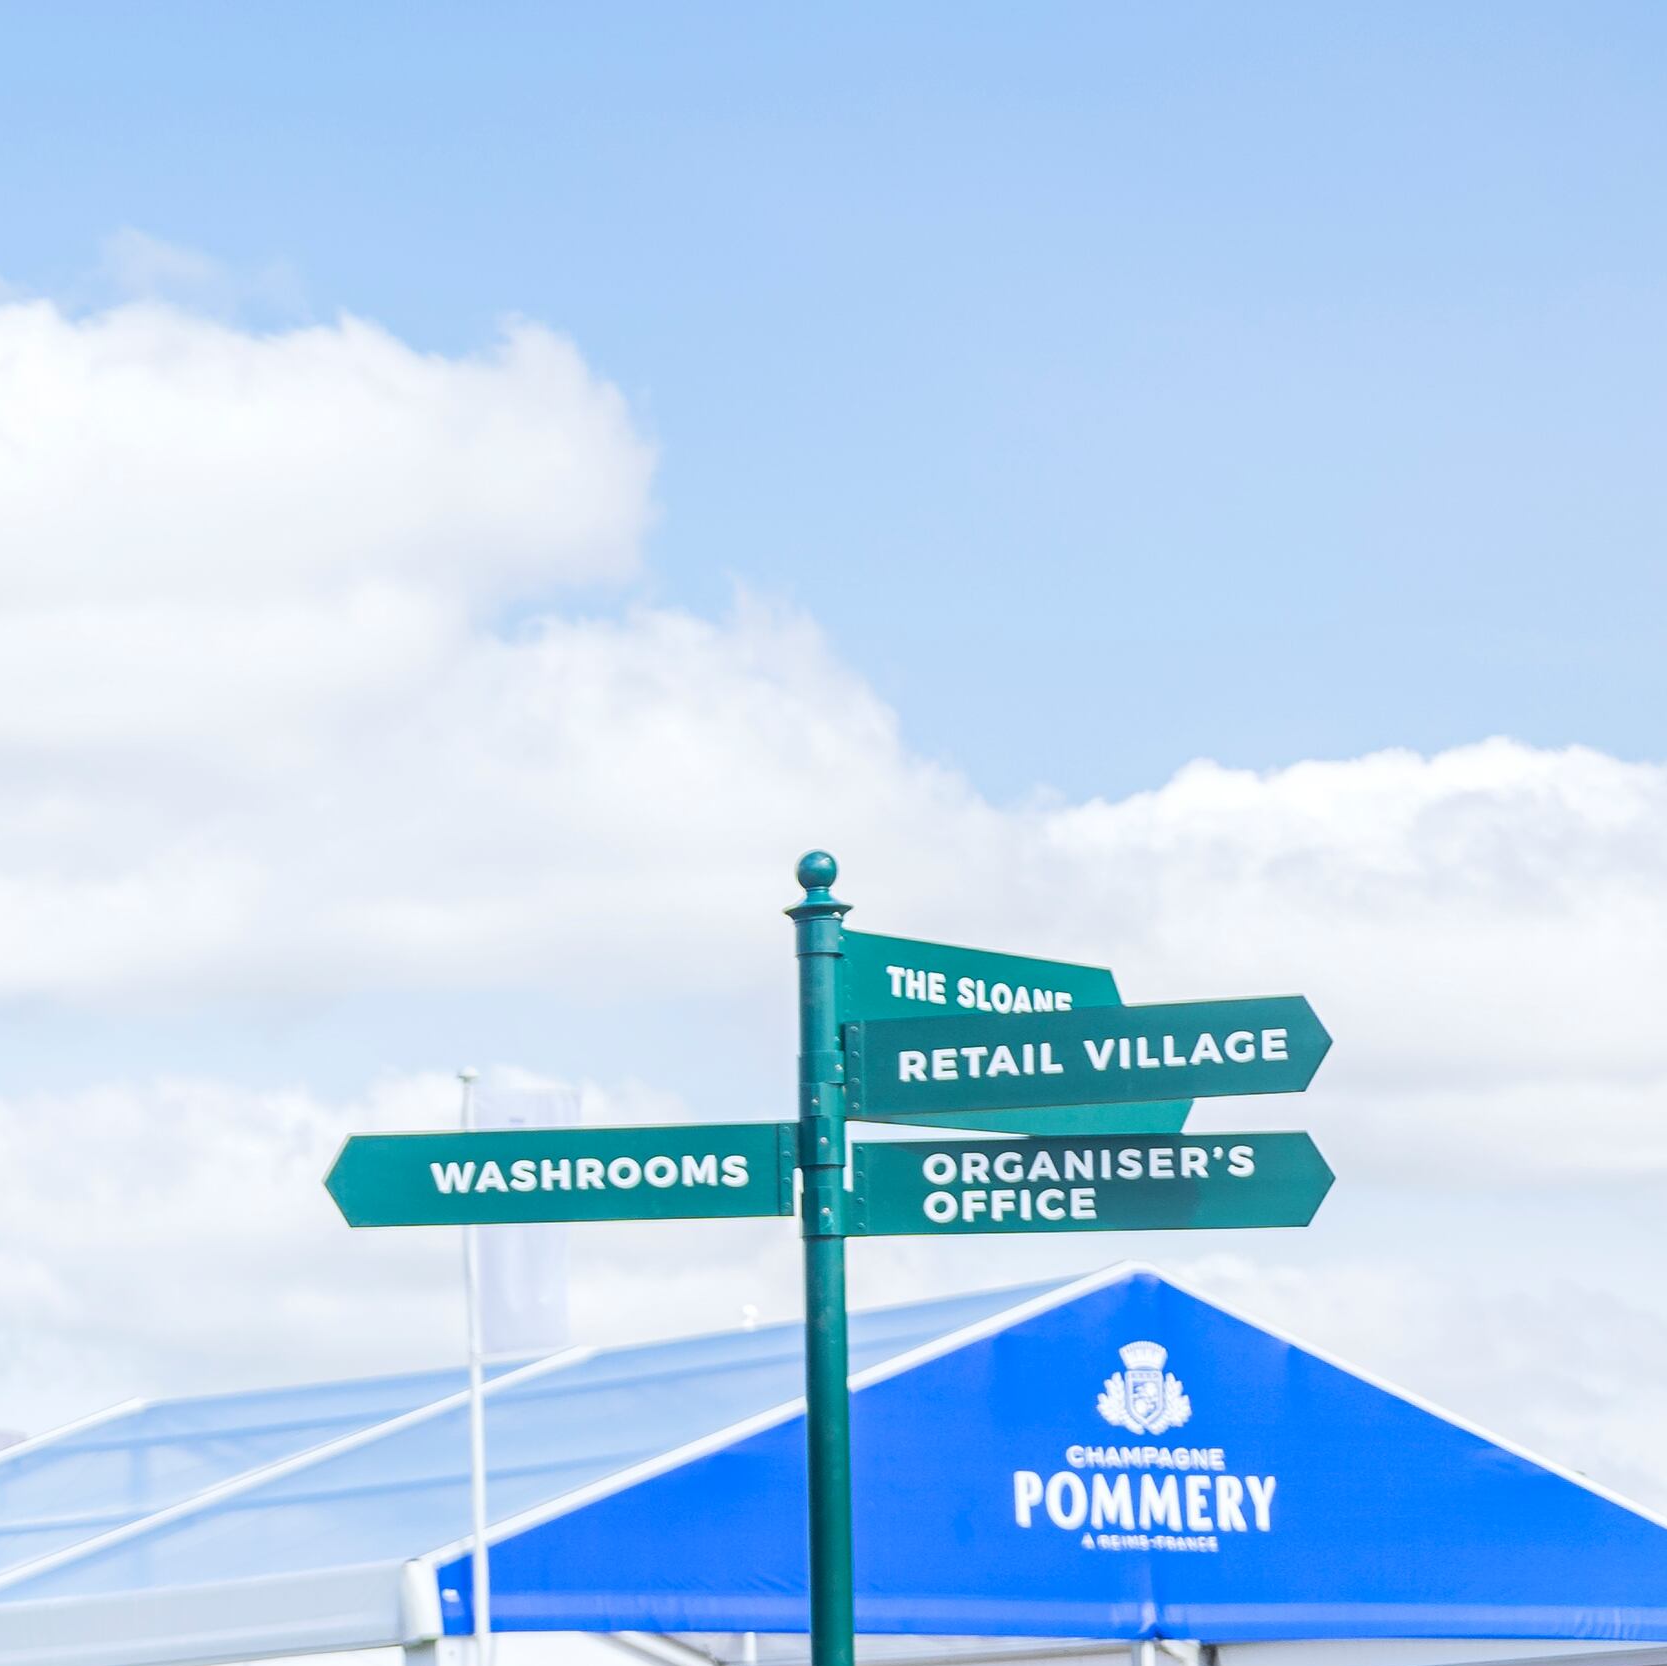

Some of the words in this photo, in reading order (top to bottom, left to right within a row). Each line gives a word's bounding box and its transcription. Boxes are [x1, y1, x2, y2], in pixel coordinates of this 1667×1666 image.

[886, 965, 947, 1005] THE
[956, 976, 1073, 1014] SLOANE
[898, 1042, 1064, 1082] RETAIL
[1082, 1028, 1289, 1071] VILLAGE
[430, 1154, 750, 1194] WASHROOMS
[922, 1145, 1255, 1185] ORGANISER'S
[923, 1186, 1098, 1223] OFFICE
[1065, 1445, 1225, 1471] CHAMPAGNE
[1013, 1470, 1276, 1532] POMMERY
